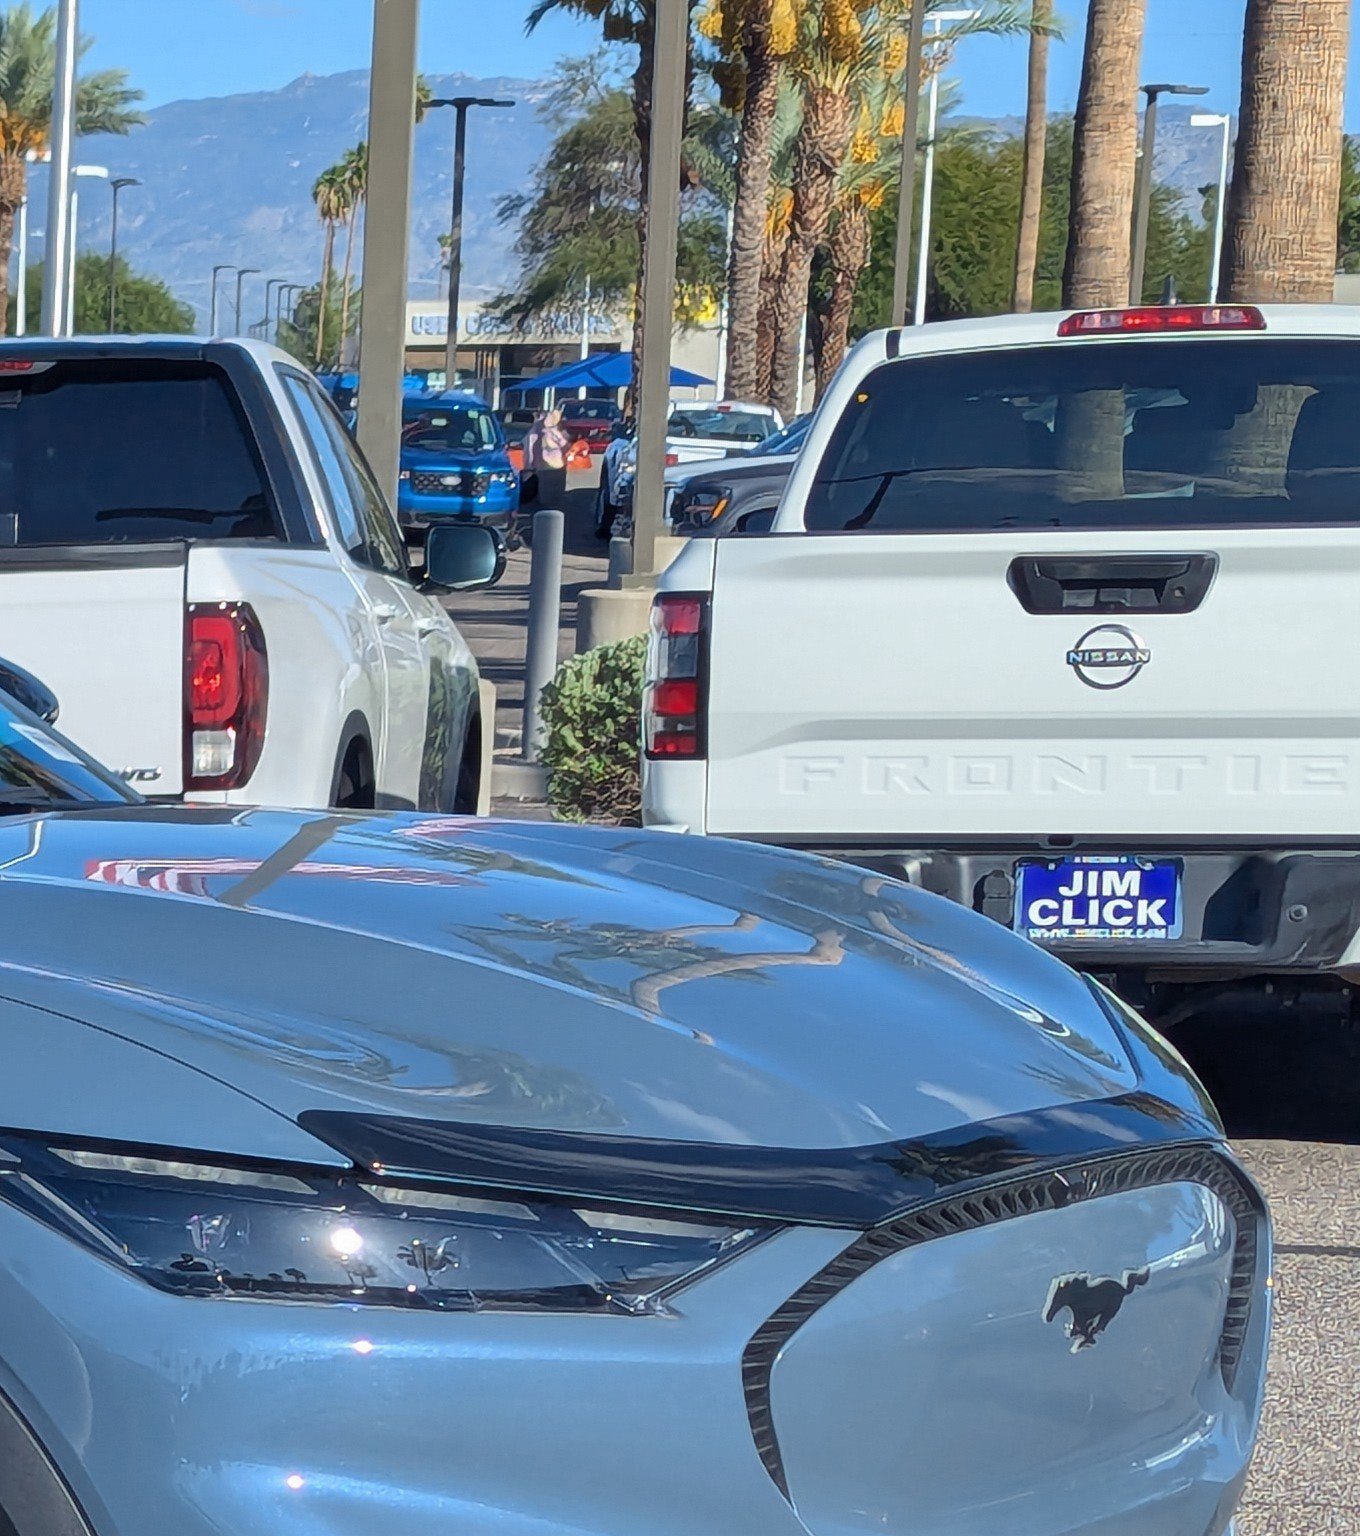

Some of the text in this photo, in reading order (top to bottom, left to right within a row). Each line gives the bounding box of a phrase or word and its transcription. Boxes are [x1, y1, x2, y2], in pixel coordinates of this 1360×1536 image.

[1068, 650, 1149, 663] NISSAN
[782, 755, 1348, 796] FRONTIE
[1057, 869, 1142, 898] JIM
[1027, 898, 1168, 927] CLICK
